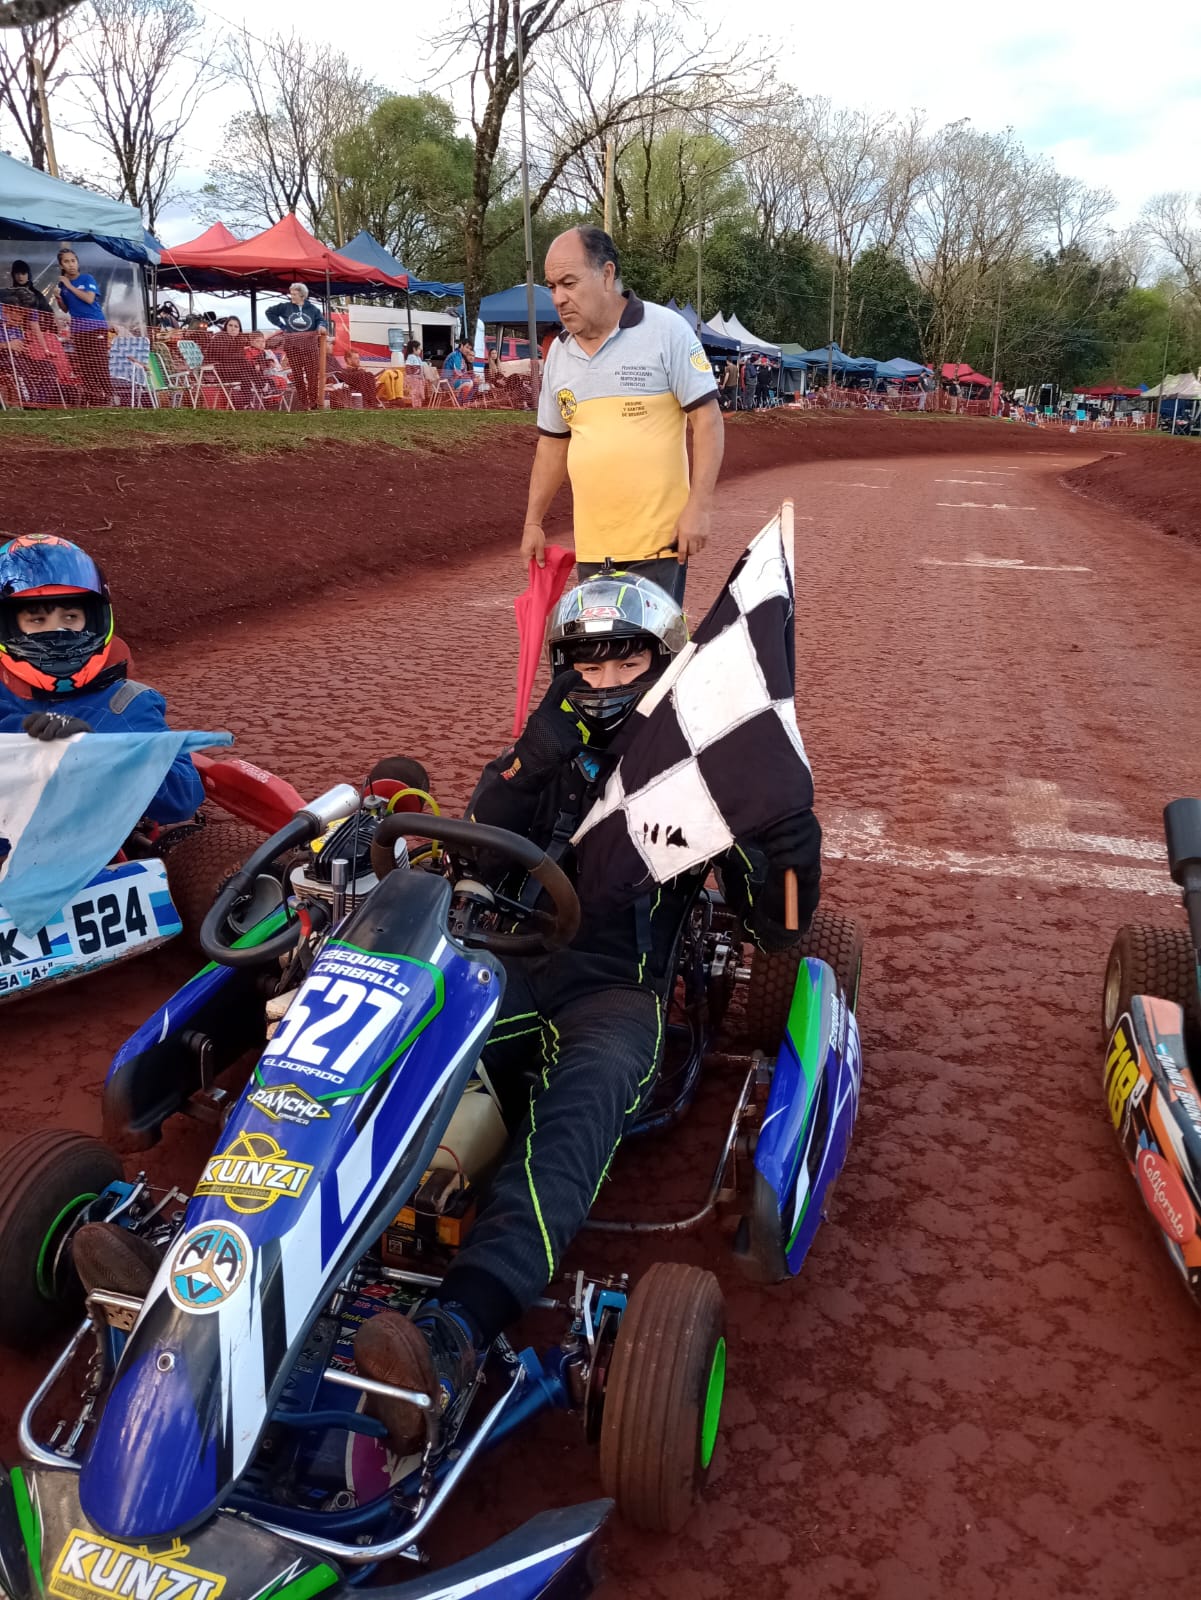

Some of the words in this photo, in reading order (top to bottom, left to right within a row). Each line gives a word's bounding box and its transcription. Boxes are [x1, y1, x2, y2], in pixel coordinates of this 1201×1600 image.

[0, 928, 29, 966] K
[72, 886, 147, 955] 524
[313, 962, 410, 997] CARBALLO
[317, 949, 401, 976] EZEQUIEL
[263, 976, 403, 1074] 527
[263, 1058, 345, 1085] ELDORADO
[251, 1088, 322, 1118] PANCHO
[201, 1158, 308, 1191] KUNZI
[1143, 1153, 1184, 1238] California
[61, 1537, 217, 1600] KUNZI
